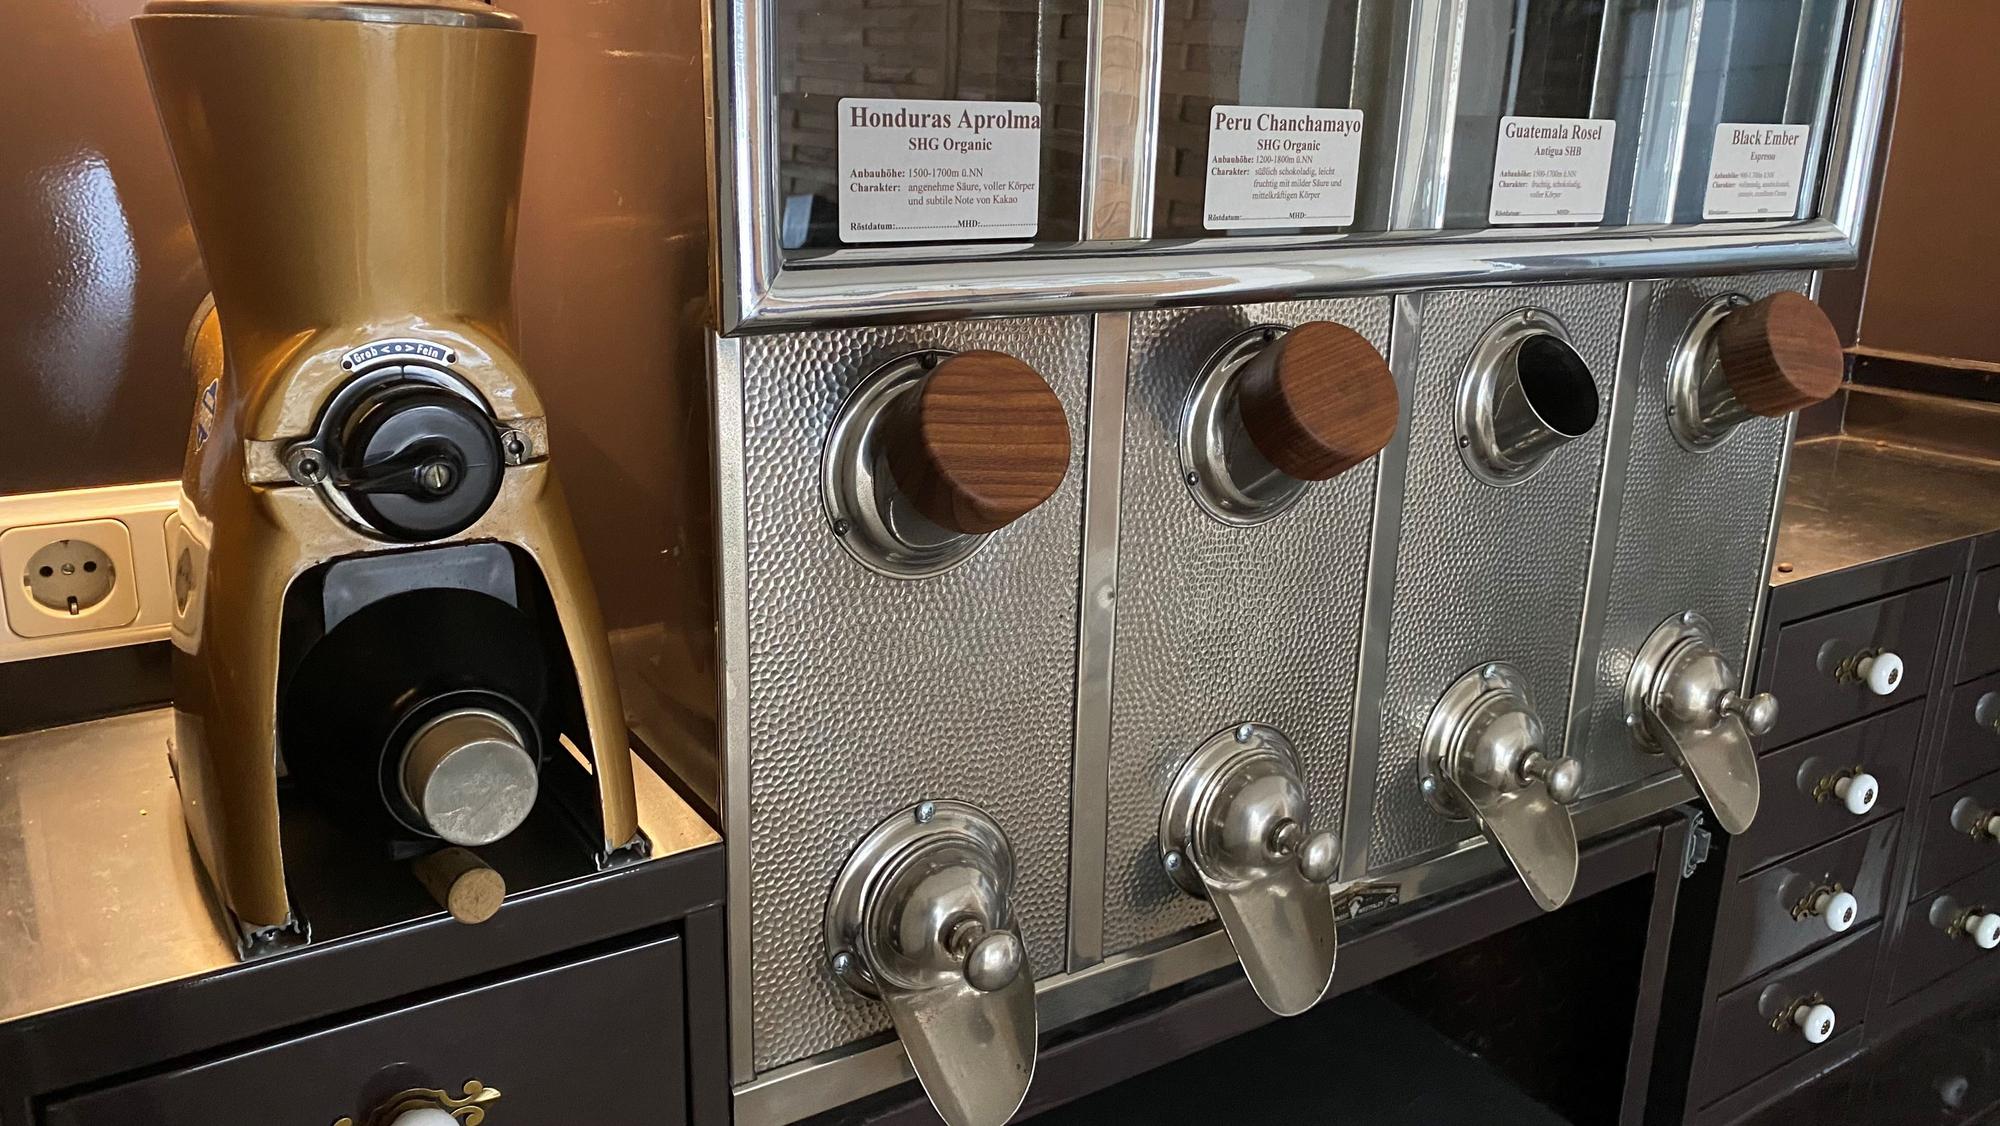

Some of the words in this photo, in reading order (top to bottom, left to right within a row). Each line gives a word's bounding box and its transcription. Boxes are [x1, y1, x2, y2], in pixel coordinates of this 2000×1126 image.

[850, 107, 951, 128] Honduras
[957, 109, 1041, 134] Aprolma
[1215, 112, 1251, 131] Peru
[1257, 113, 1361, 137] Chanchamayo
[1506, 122, 1568, 139] Guatemala
[1571, 125, 1602, 140] Rosel
[1732, 130, 1762, 144] Black
[1764, 130, 1799, 145] Ember
[908, 138, 939, 151] SHG
[944, 138, 992, 154] Organic
[1257, 139, 1281, 151] SHG
[1283, 139, 1321, 153] Organic
[1535, 146, 1562, 158] Antigua
[1564, 146, 1582, 156] SHB
[850, 168, 905, 178] Anbauhöhe:
[908, 168, 959, 178] 1500-1700m
[1211, 167, 1250, 176] Charakter:
[850, 183, 900, 193] Charakter:
[908, 183, 954, 195] angenehme
[956, 182, 982, 193] Säure,
[983, 181, 1006, 191] voller
[1008, 181, 1035, 193] Körper
[908, 195, 924, 206] und
[925, 195, 952, 206] subtile
[954, 195, 974, 205] Note
[976, 196, 990, 204] von
[992, 194, 1018, 204] Kakao
[353, 347, 378, 363] Grob
[416, 343, 439, 358] Fein
